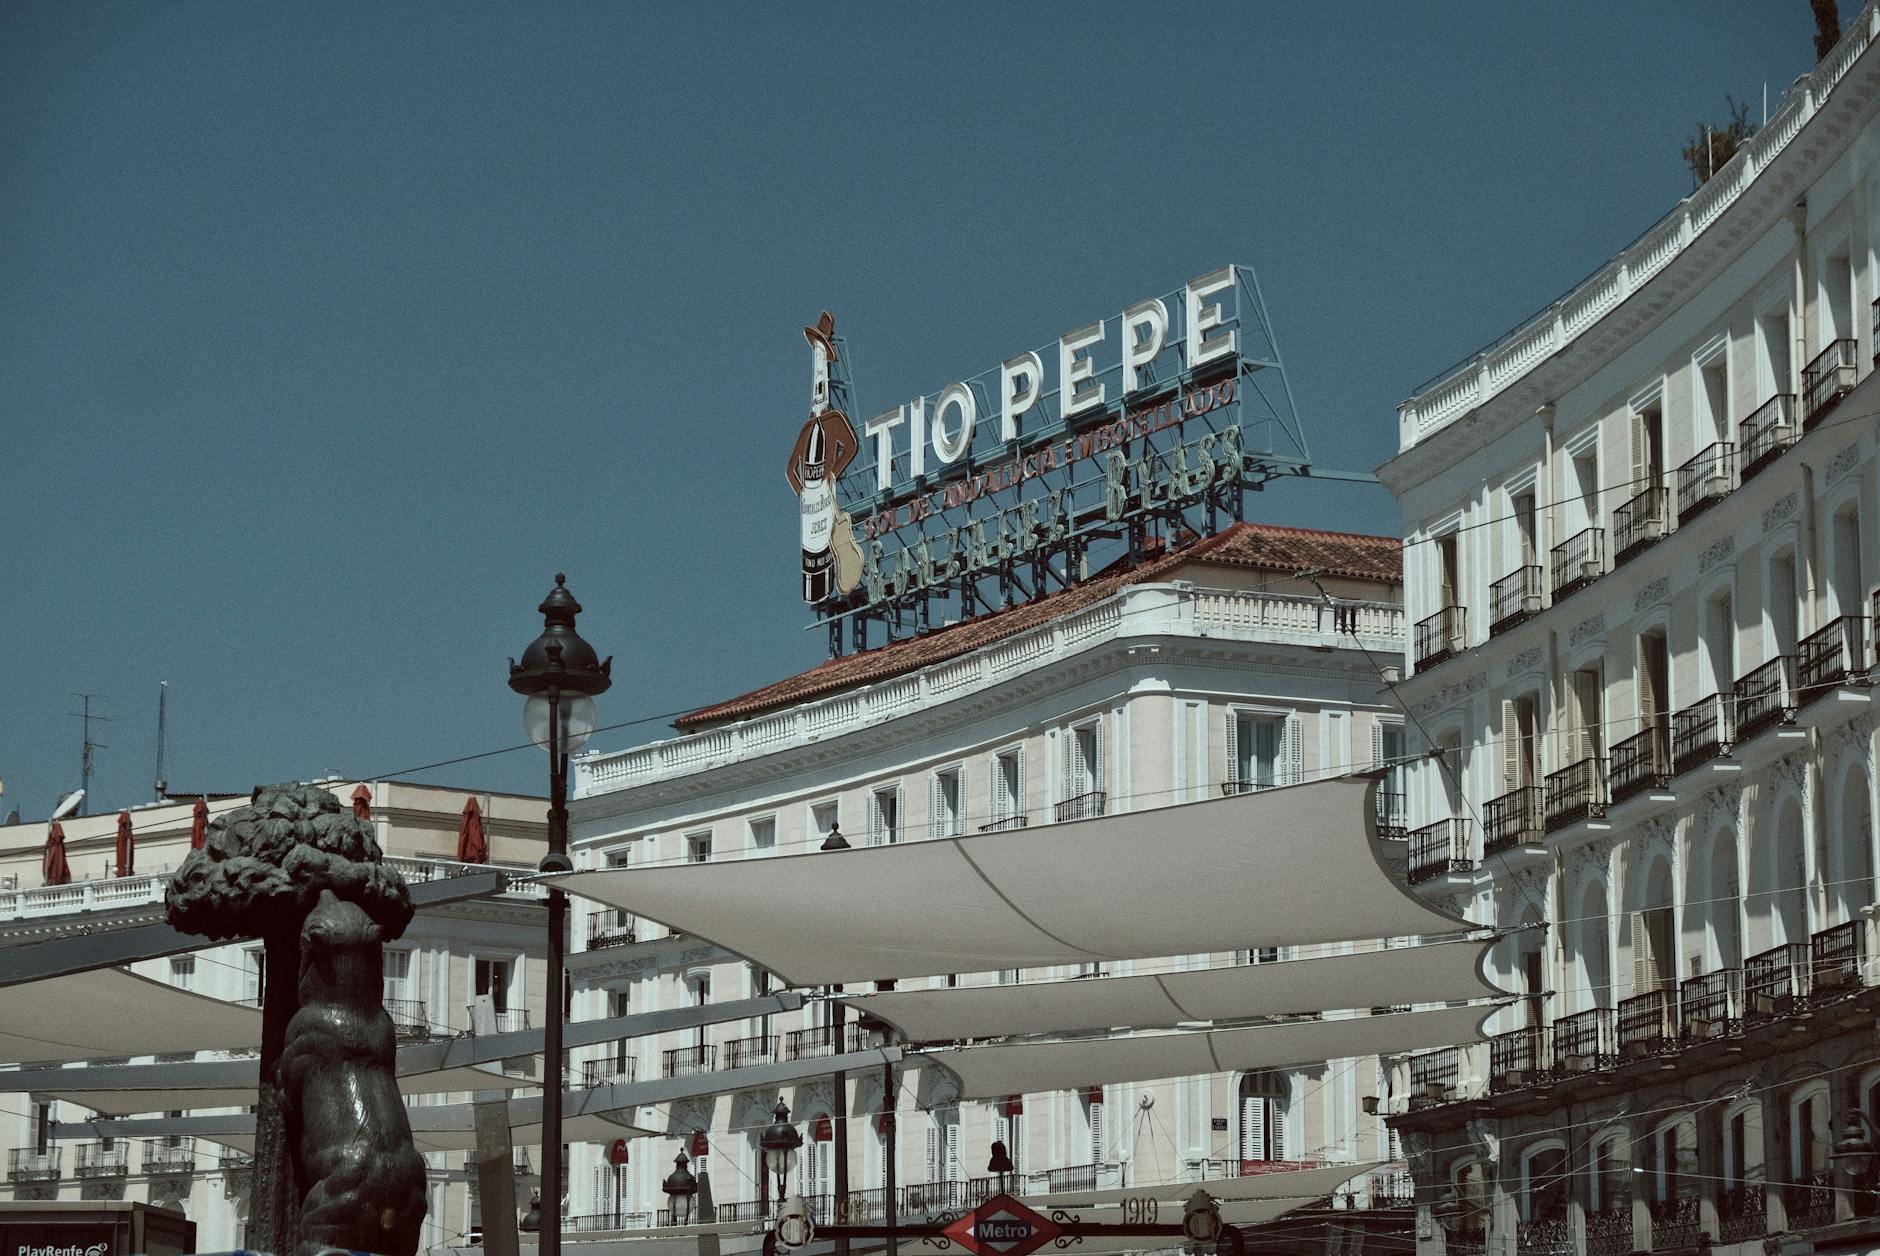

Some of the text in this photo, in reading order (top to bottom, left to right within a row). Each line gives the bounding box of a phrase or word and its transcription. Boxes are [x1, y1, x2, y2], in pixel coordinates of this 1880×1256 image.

[865, 263, 1235, 491] TIO PEPE
[1106, 424, 1241, 523] BYASS
[864, 510, 902, 540] SOL
[909, 493, 933, 524] DE
[1121, 1197, 1158, 1224] 1919
[978, 1223, 1028, 1239] Metro
[18, 1244, 83, 1256] PlayRenfe
